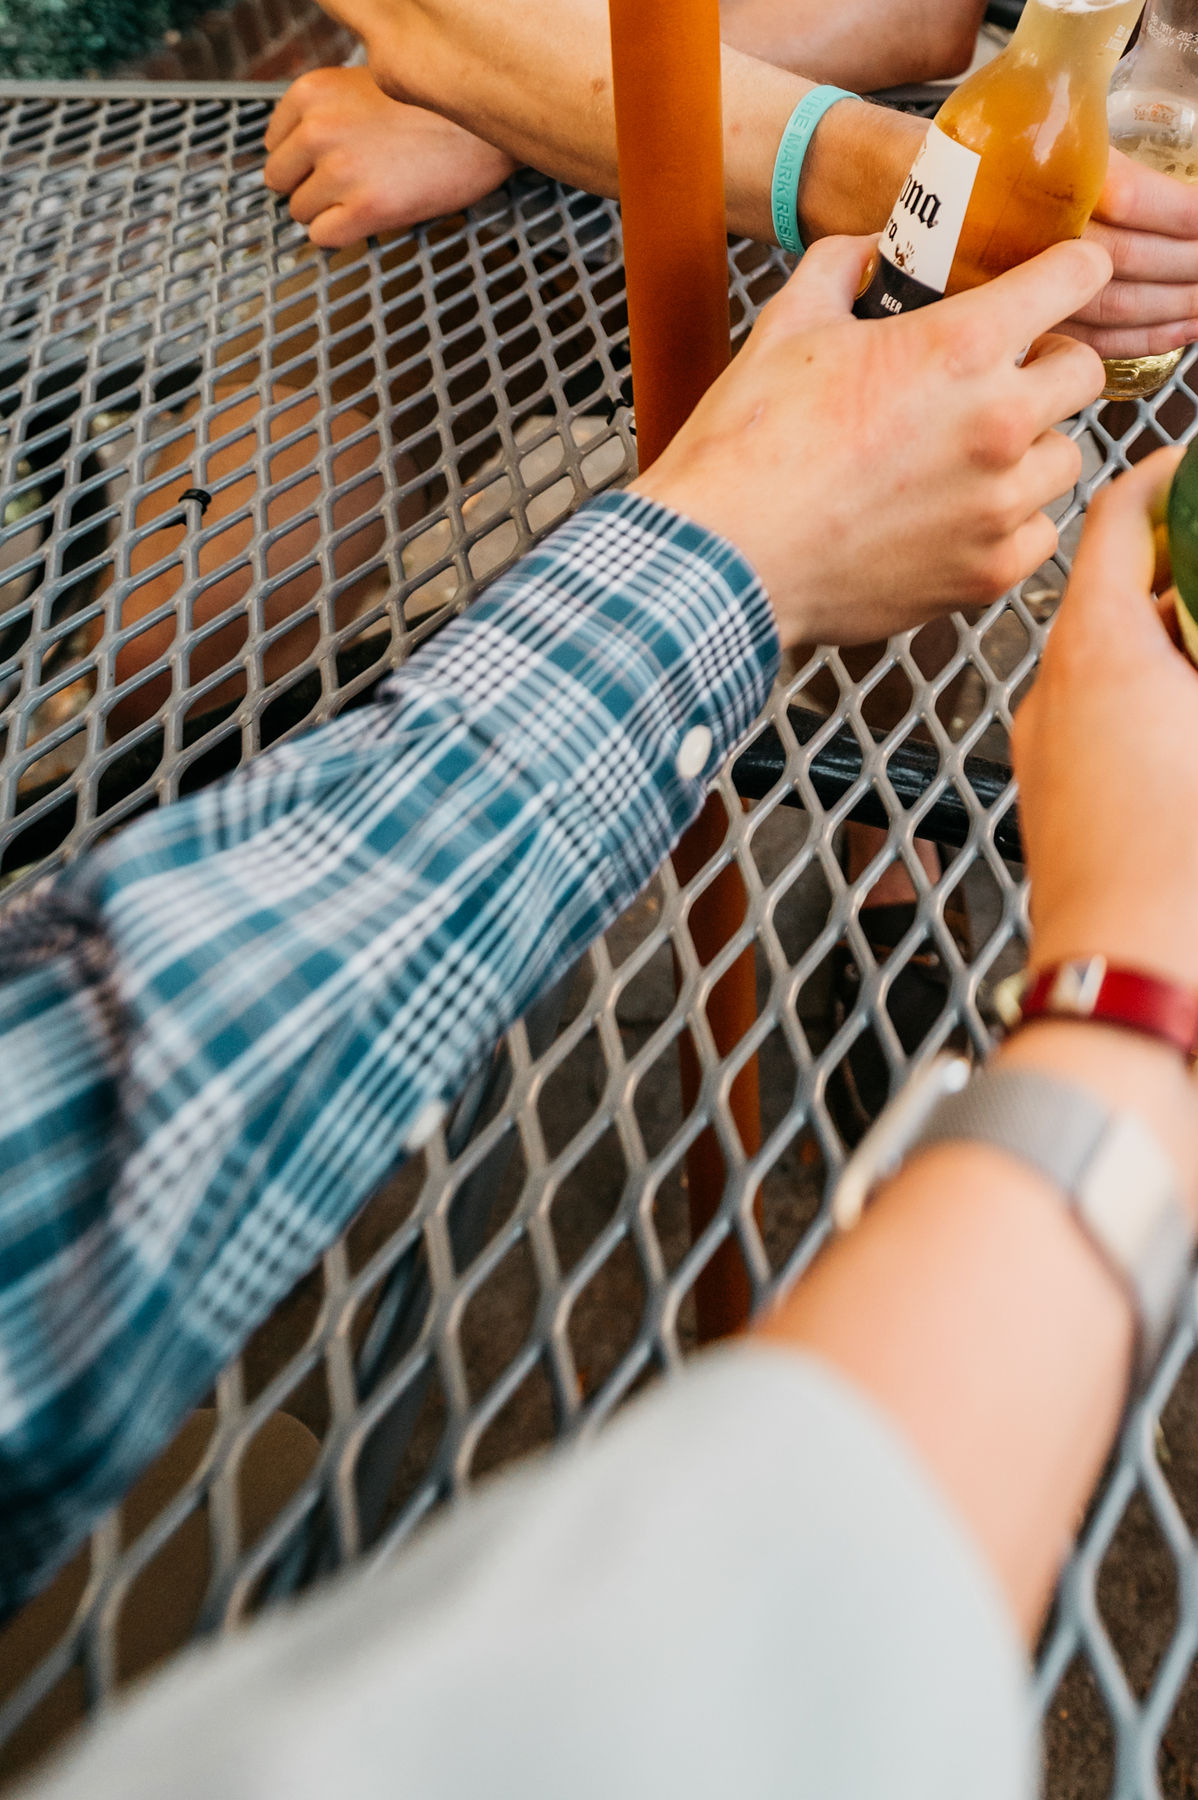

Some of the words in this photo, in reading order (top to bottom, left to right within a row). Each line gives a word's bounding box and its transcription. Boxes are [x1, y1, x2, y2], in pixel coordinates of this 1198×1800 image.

[793, 95, 828, 129] THE
[776, 132, 802, 196] MARK
[880, 293, 903, 314] BEER
